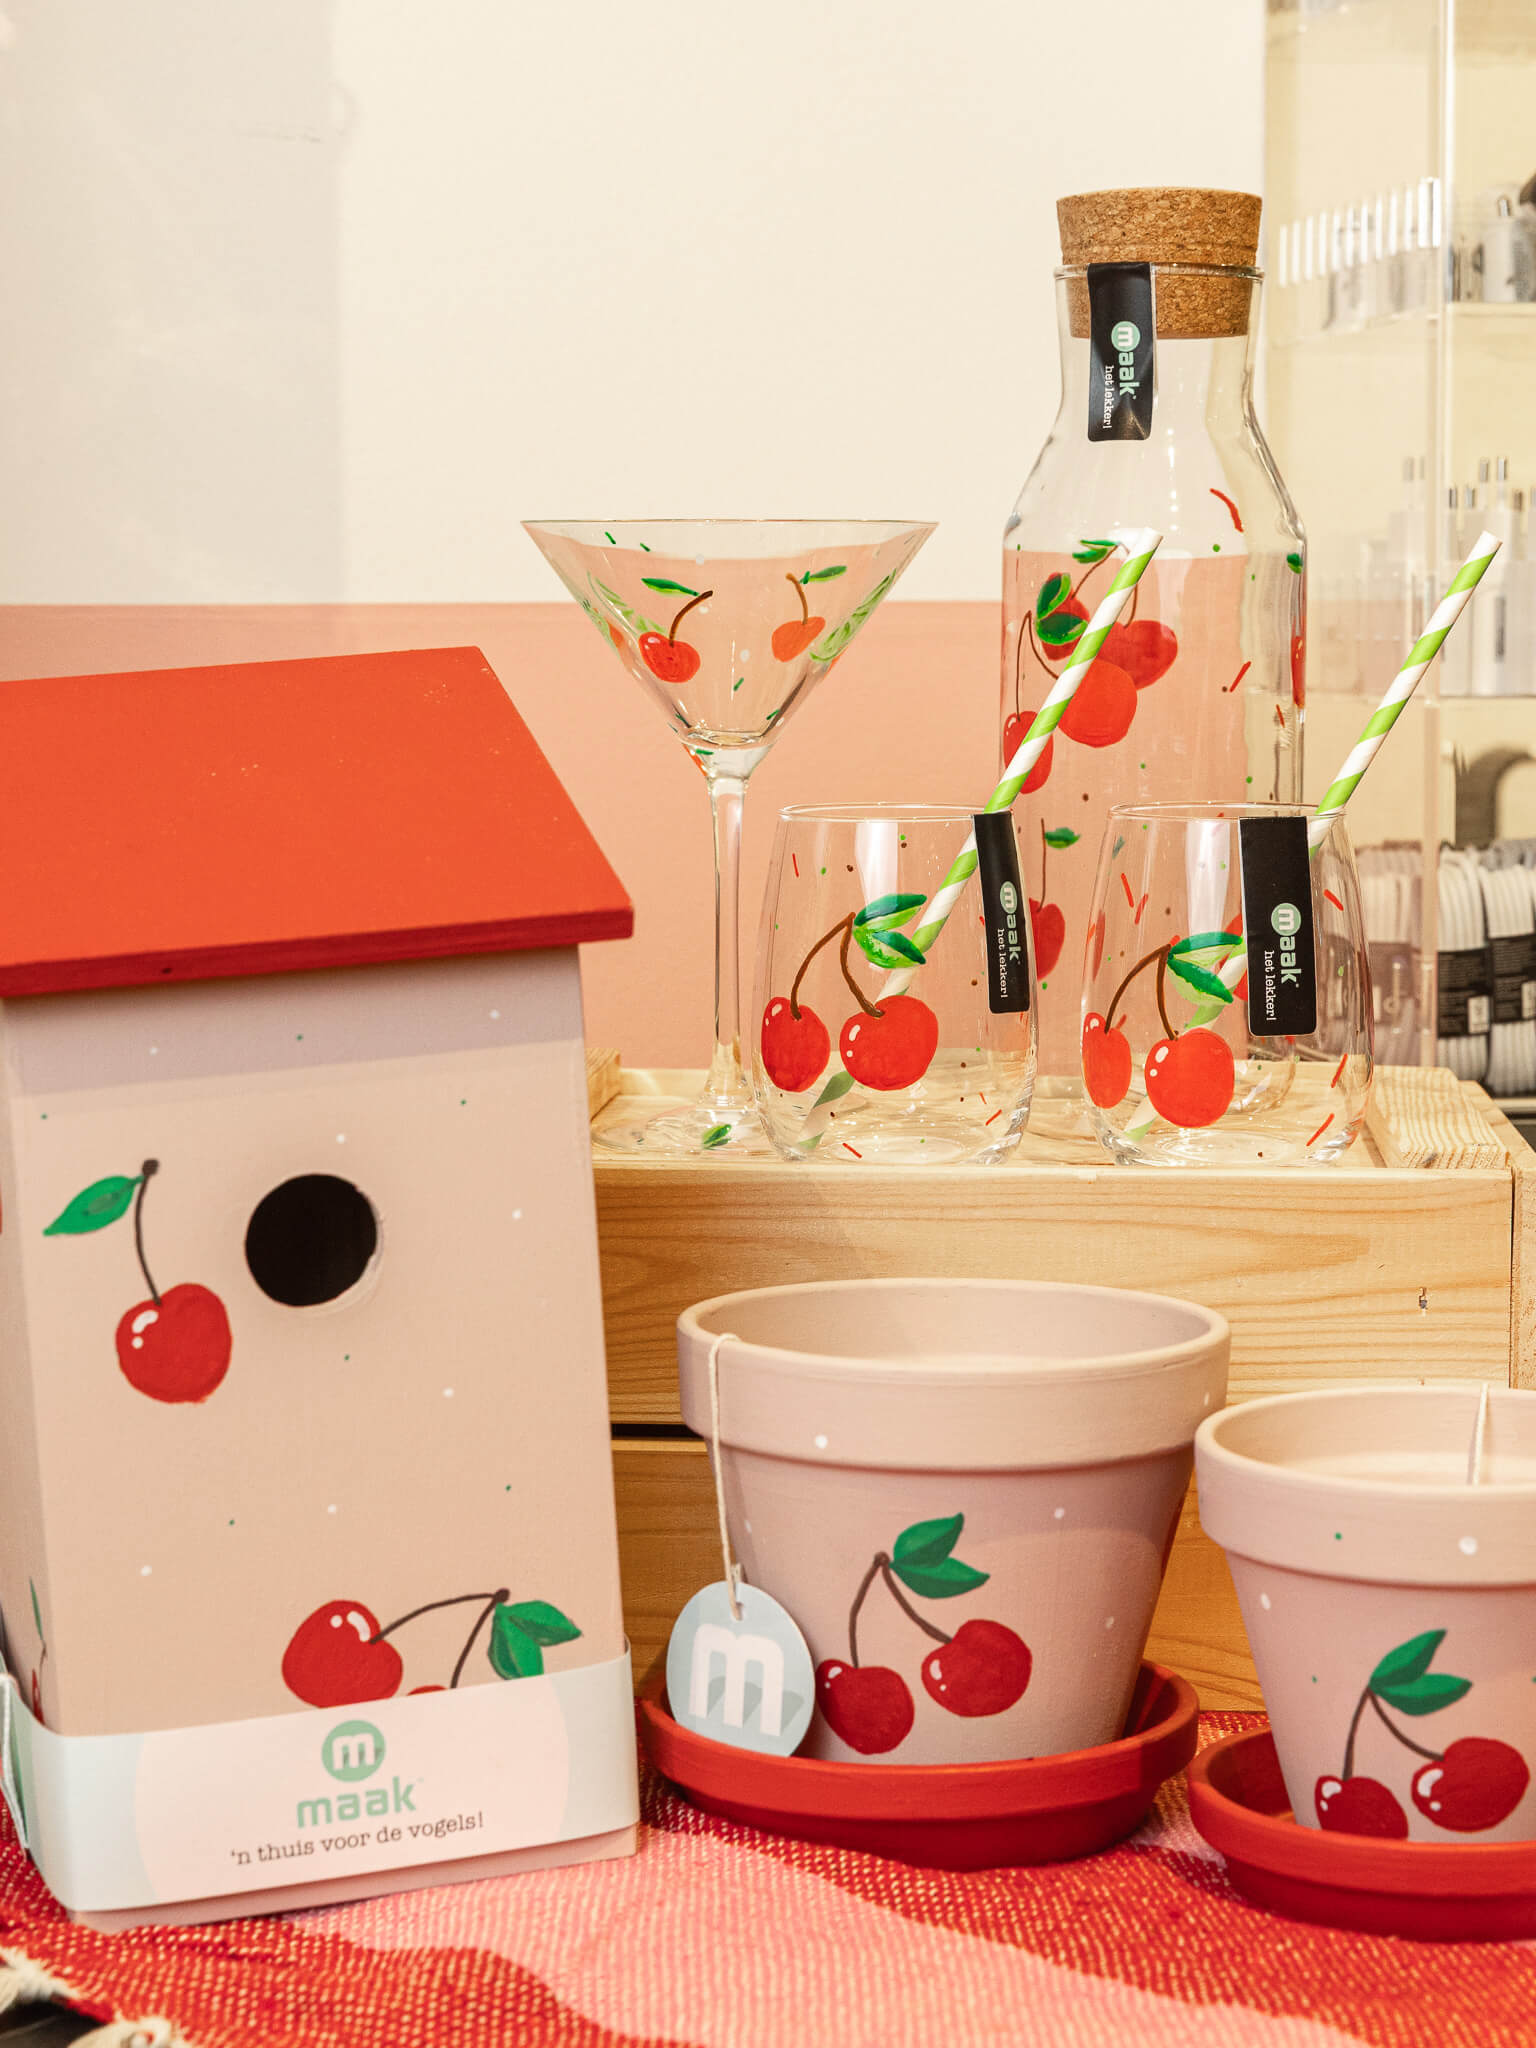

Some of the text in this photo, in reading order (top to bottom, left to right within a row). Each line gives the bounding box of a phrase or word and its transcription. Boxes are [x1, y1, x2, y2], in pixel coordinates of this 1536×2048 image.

[1103, 365, 1115, 385] het
[1113, 322, 1141, 396] maak
[997, 928, 1005, 951] het
[1001, 882, 1022, 961] maak
[1273, 905, 1302, 984] maak
[1264, 950, 1275, 973] het
[687, 1623, 785, 1737] m
[331, 1732, 376, 1771] m
[296, 1776, 416, 1829] maak
[257, 1840, 315, 1863] thuis
[320, 1832, 371, 1853] voor
[376, 1826, 401, 1843] de
[408, 1811, 484, 1839] vogels!
